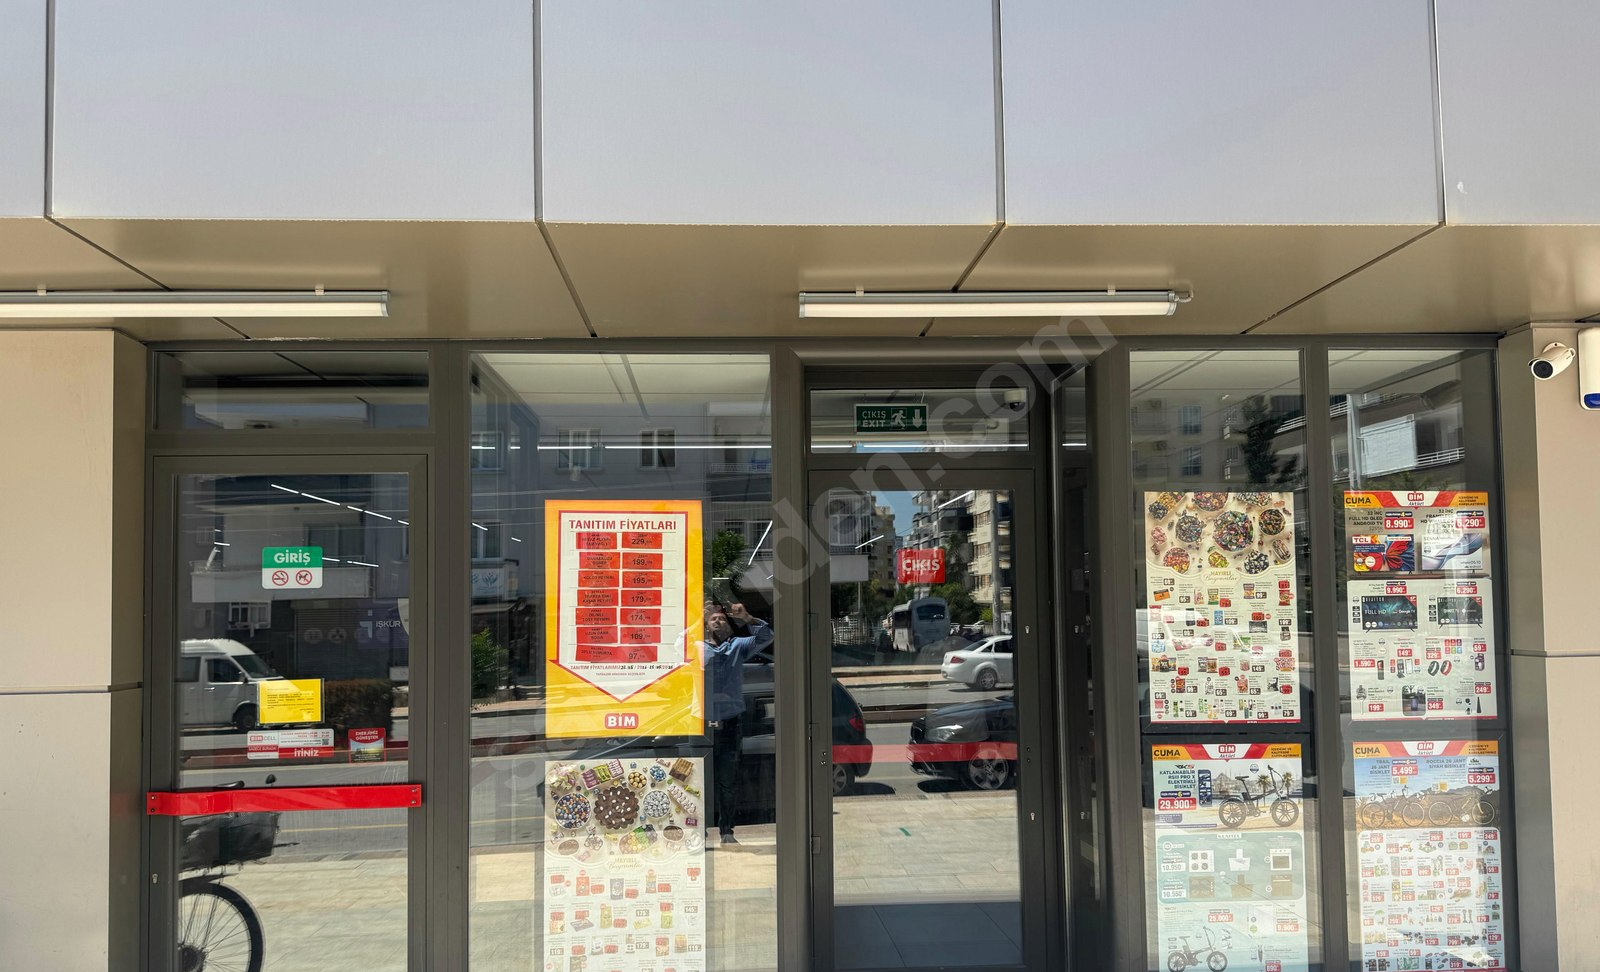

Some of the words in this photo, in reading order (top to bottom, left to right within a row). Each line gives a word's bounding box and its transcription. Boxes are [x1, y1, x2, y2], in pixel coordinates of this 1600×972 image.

[862, 410, 886, 420] ÇIKIŞ
[862, 420, 886, 428] EXIT
[569, 520, 616, 530] TANITIM
[620, 518, 676, 530] FİYATLARI
[1386, 519, 1408, 528] 8.990
[1457, 518, 1480, 527] 6.290
[274, 551, 311, 566] GİRİŞ
[608, 714, 636, 727] BİM
[294, 748, 320, 757] İTİNİZ
[1392, 766, 1413, 774] 5.499
[1469, 775, 1490, 783] 5.299
[1160, 800, 1190, 810] 29.900
